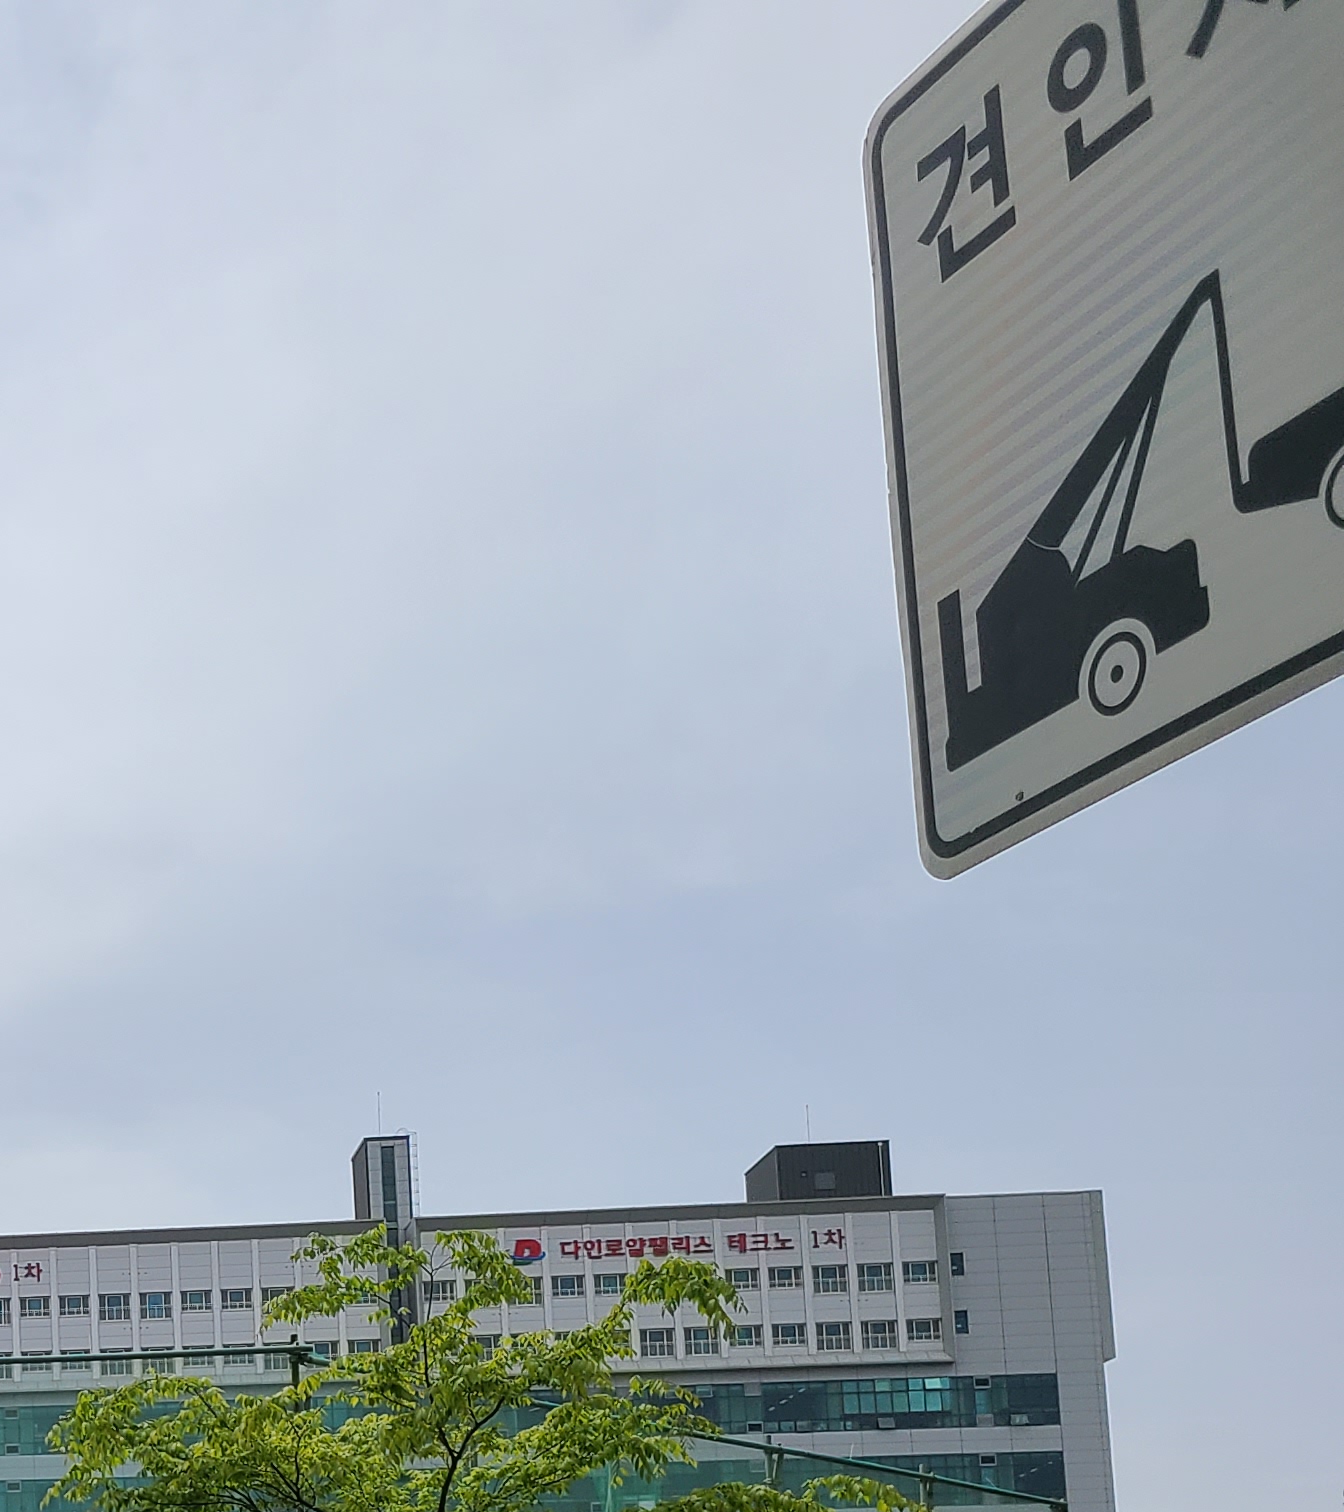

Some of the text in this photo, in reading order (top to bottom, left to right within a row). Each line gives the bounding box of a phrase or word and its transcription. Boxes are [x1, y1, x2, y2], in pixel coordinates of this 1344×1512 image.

[727, 1232, 794, 1254] 테크노
[811, 1228, 846, 1250] 1차
[13, 1262, 43, 1283] 1차
